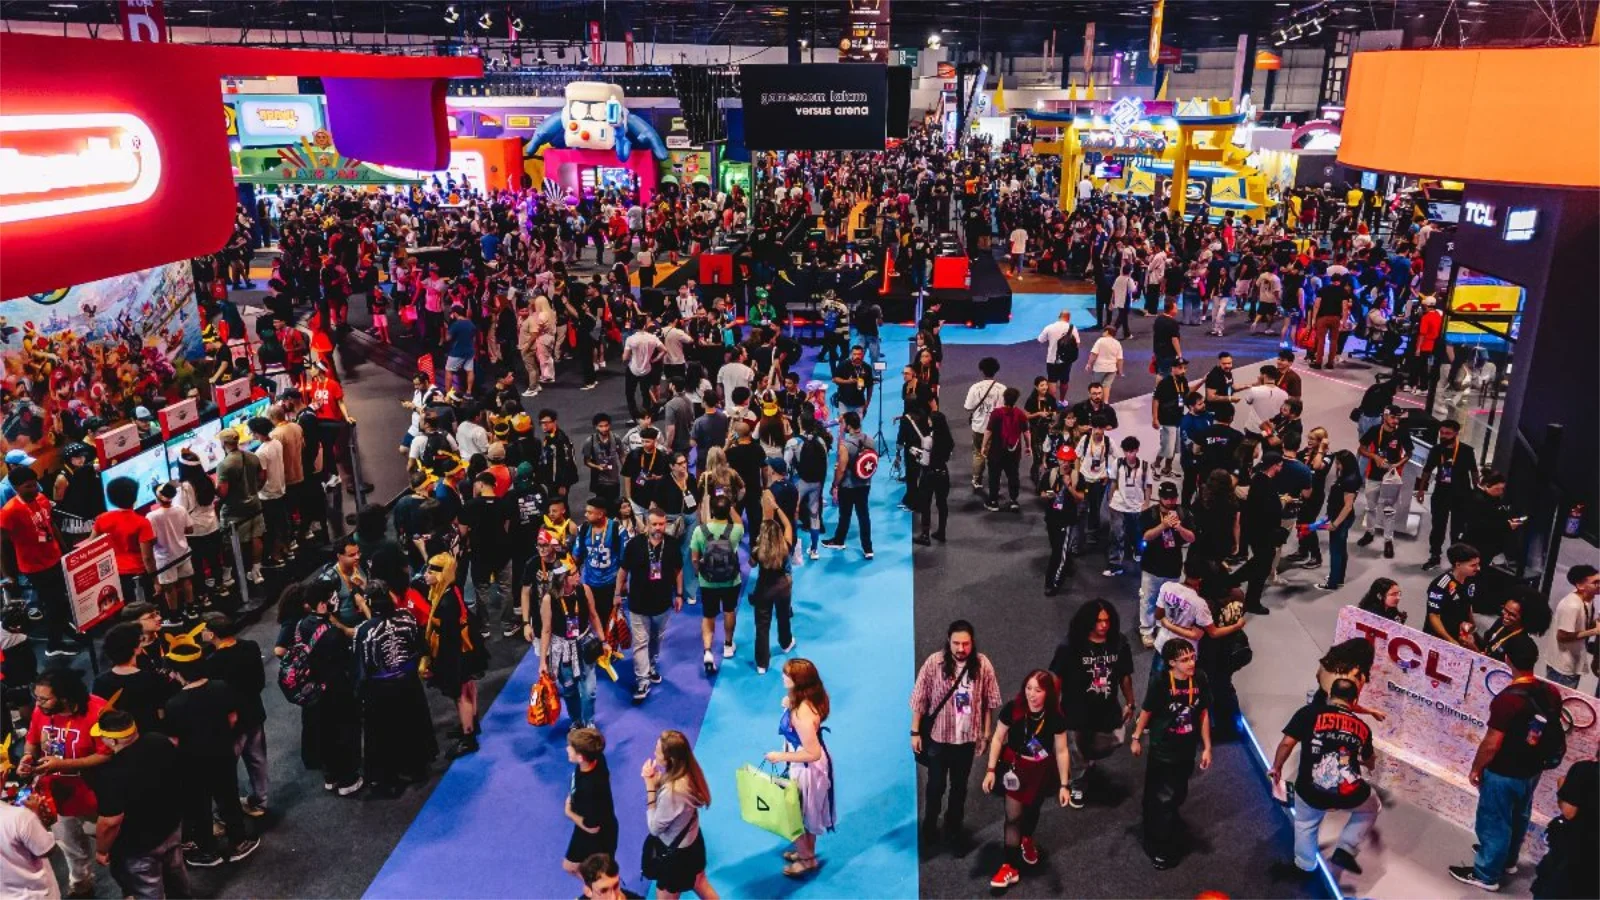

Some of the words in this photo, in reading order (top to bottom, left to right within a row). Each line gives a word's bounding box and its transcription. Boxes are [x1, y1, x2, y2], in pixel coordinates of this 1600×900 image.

[795, 106, 831, 116] versus
[834, 105, 869, 116] arena
[1465, 201, 1497, 227] TCL
[1355, 622, 1453, 685] TCL
